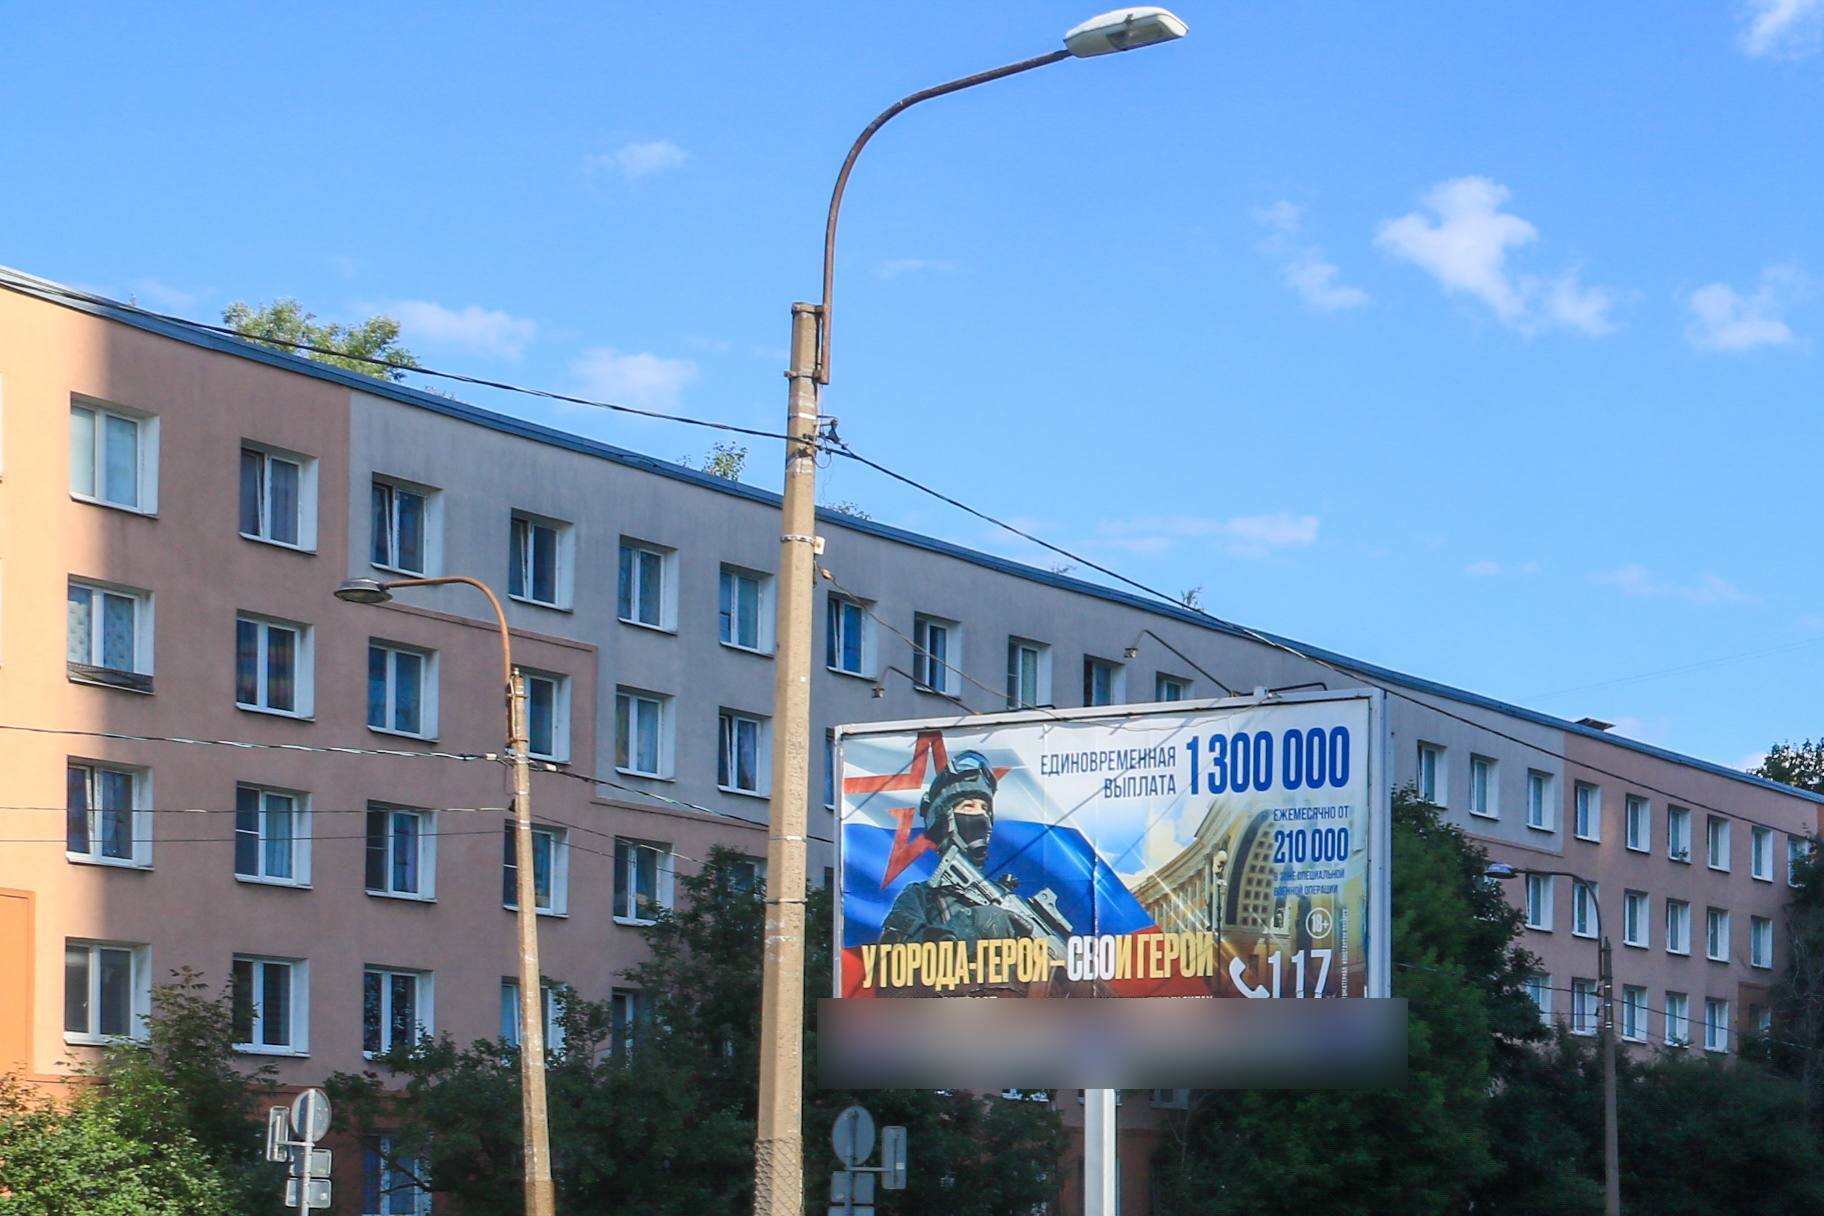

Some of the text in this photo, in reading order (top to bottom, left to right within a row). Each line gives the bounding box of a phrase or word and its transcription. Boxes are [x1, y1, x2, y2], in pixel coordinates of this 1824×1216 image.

[1040, 746, 1176, 776] ЕДИНОВРЕМЕННАЯ
[1186, 725, 1350, 796] 1 300 000
[1104, 774, 1177, 799] ВЫПЛАТА
[1273, 805, 1350, 821] ЕЖЕМЕСЯЧНО ОТ
[1273, 827, 1349, 864] 210 000
[1311, 914, 1330, 933] 18+
[862, 944, 877, 989] У
[880, 936, 1048, 991] ГОРОДА-ГЕРОЯ
[1067, 934, 1132, 982] СВОИ
[1137, 931, 1214, 978] ГЕРОИ
[1268, 949, 1332, 998] 117
